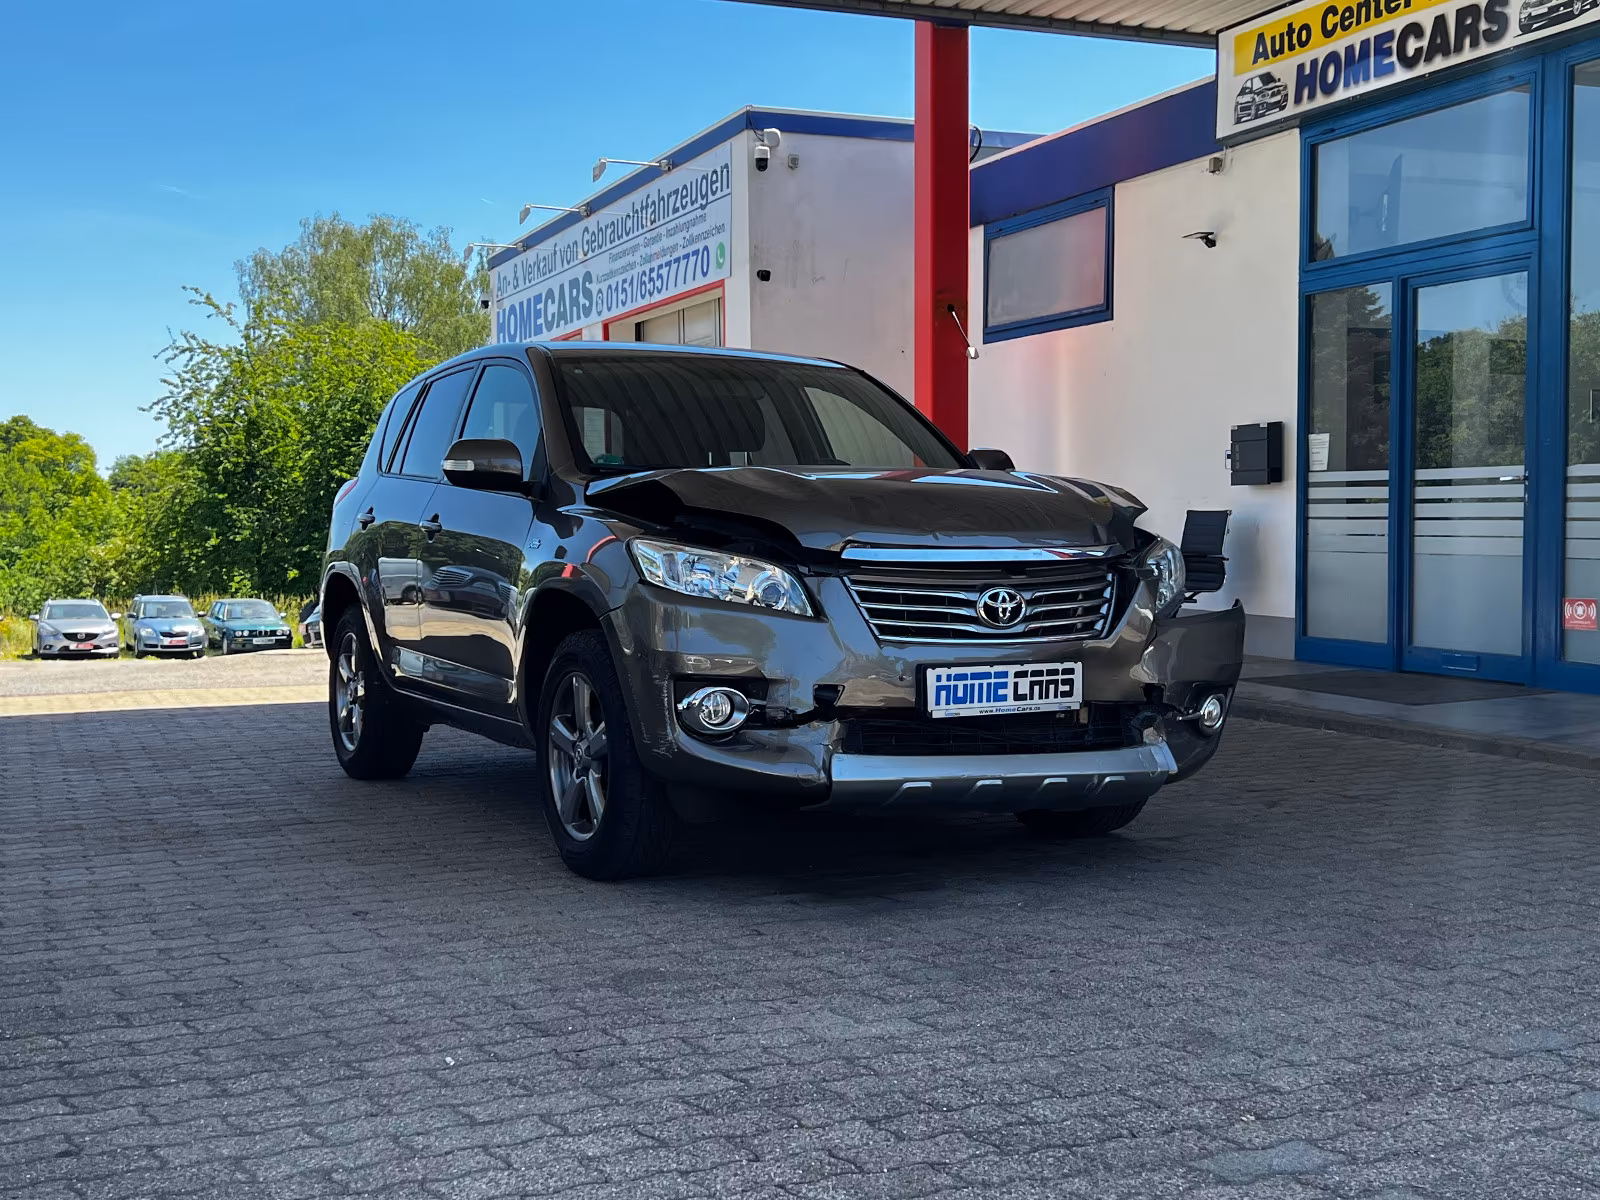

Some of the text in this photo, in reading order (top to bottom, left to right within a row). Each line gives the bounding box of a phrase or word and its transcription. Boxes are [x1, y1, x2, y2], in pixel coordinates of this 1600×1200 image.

[1252, 22, 1312, 65] Auto
[1293, 0, 1509, 104] HOMECARS
[496, 162, 730, 298] An- & Verkauf von Gebrauchtfahrzeugen
[682, 222, 726, 249] Zollkennzeichen
[608, 242, 640, 264] Finanzierungen
[496, 245, 710, 344] HOMECARS 0151/65577770
[935, 667, 1075, 706] HOME CARS
